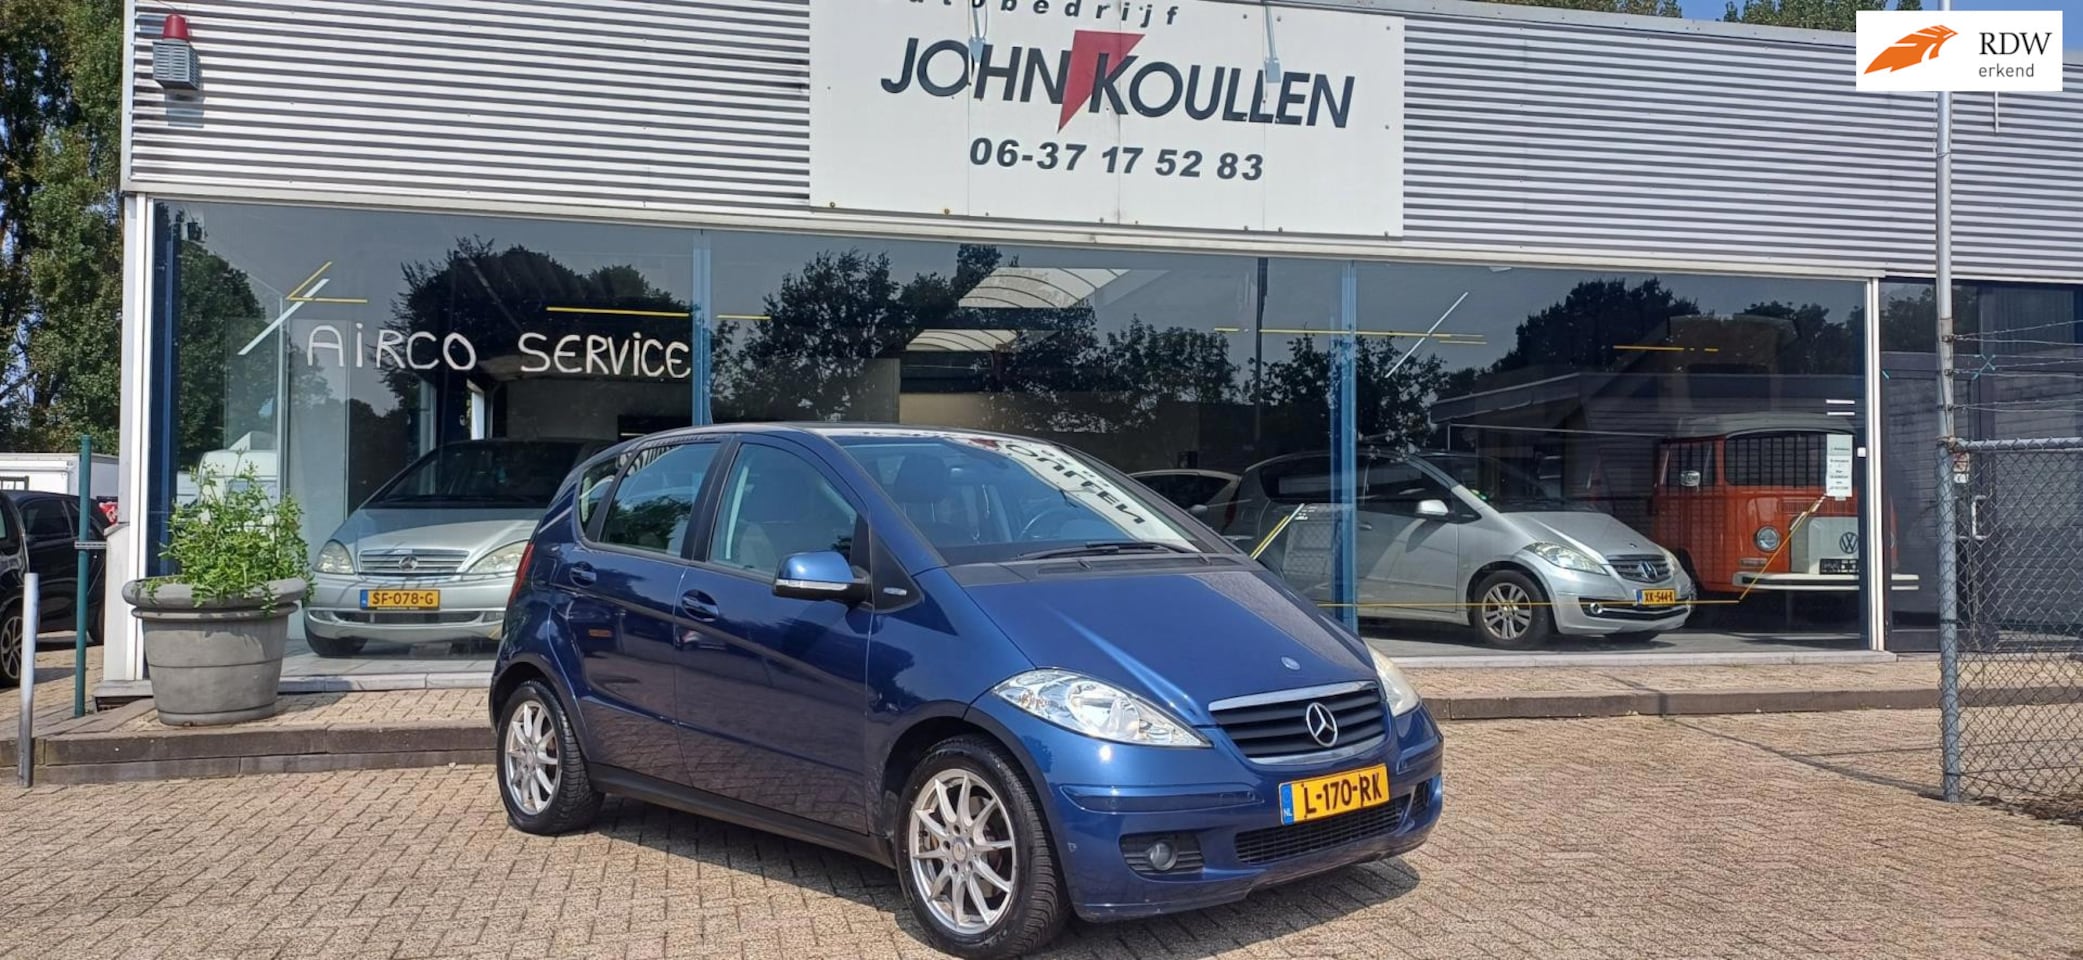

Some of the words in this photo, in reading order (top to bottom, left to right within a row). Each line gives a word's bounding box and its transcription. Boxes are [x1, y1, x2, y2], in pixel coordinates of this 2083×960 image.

[909, 0, 1178, 28] obedrijf
[880, 37, 1072, 105] JOHN
[1089, 48, 1356, 128] KOULLEN
[969, 137, 1087, 171] 06-37
[1101, 146, 1143, 175] 17
[1155, 149, 1203, 178] 52
[1216, 152, 1264, 181] 83
[371, 591, 434, 605] SF-078-G
[1303, 772, 1382, 815] L-170-RK
